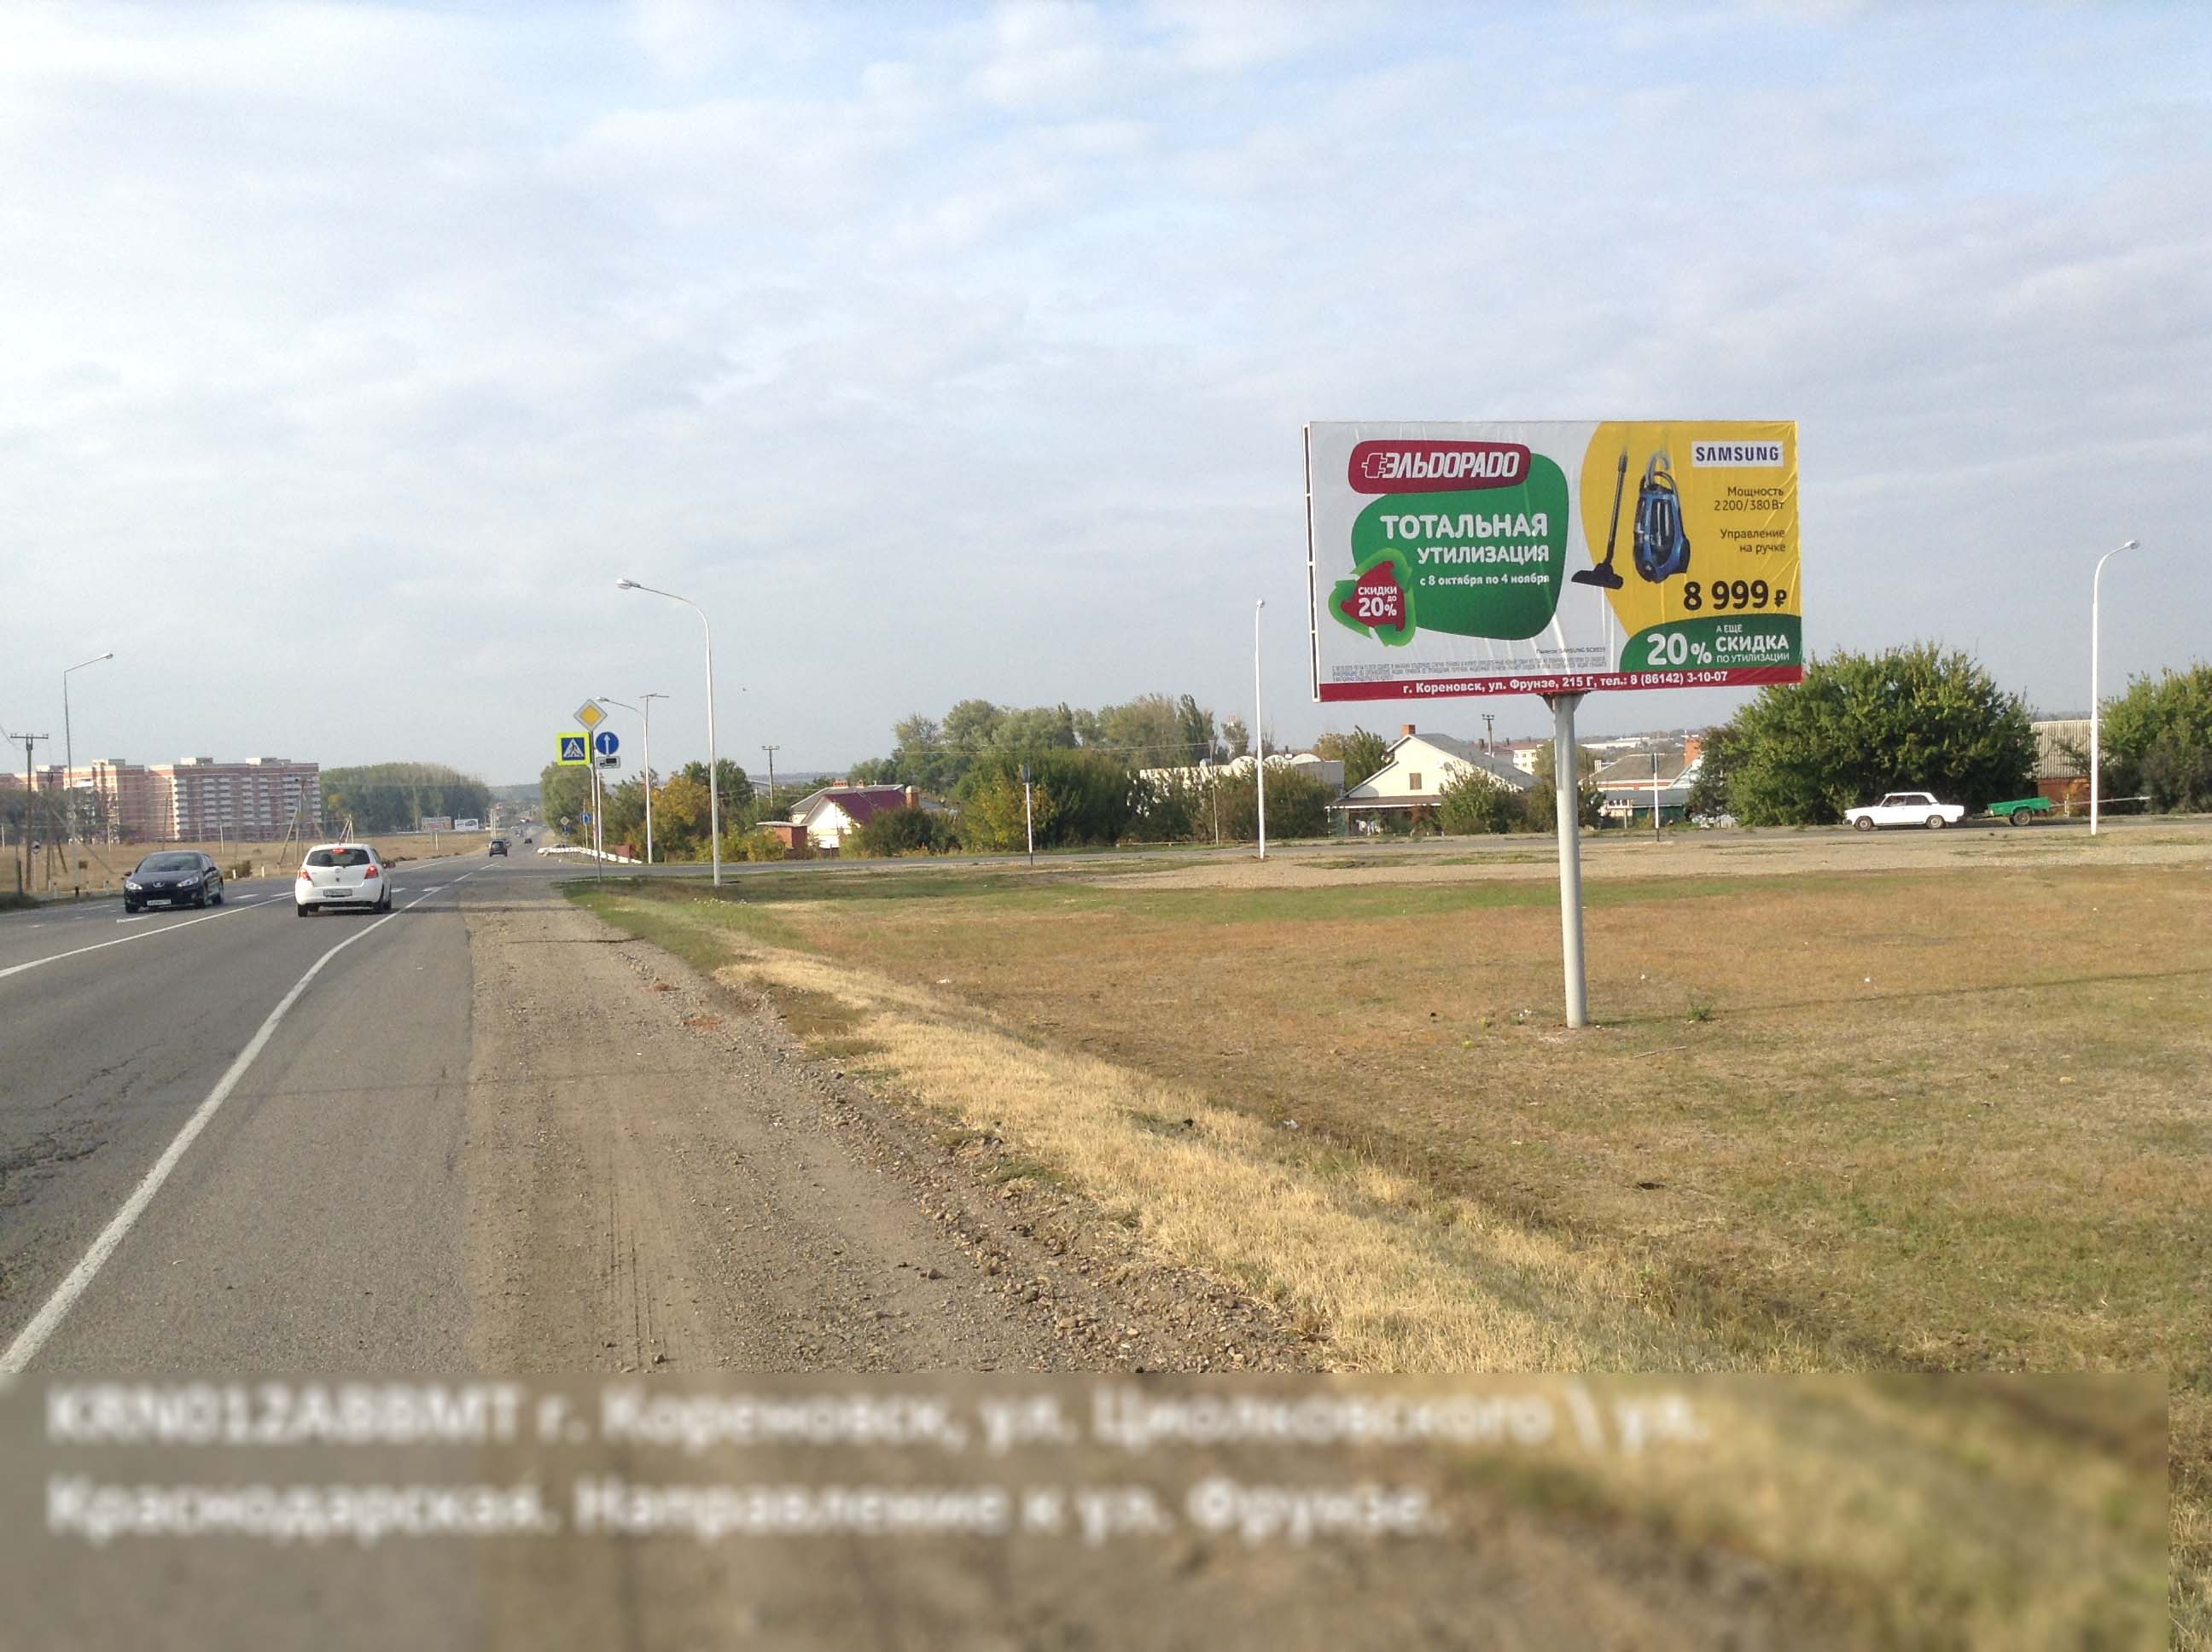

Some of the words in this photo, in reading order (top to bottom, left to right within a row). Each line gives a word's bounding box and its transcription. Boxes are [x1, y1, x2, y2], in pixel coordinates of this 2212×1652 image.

[1696, 446, 1779, 462] SAMSUNG
[1727, 486, 1784, 497] Мощность
[1380, 513, 1548, 539] ТОТАЛЬНАЯ
[1720, 528, 1785, 541] Управление
[1417, 544, 1549, 566] УТИЛИЗАЦИЯ
[1739, 544, 1753, 553] на
[1755, 543, 1786, 555] ручке
[1419, 579, 1426, 587] с
[1428, 575, 1435, 586] 8
[1438, 573, 1483, 588] октября
[1486, 574, 1499, 585] по
[1501, 573, 1509, 584] 4
[1511, 573, 1551, 585] ноября
[1358, 586, 1398, 596] СКИДКИ
[1684, 581, 1703, 611] 8
[1711, 579, 1769, 610] 999
[1358, 596, 1398, 617] 20%
[1715, 625, 1722, 633] А
[1724, 624, 1743, 634] ЕЩЕ
[1715, 635, 1790, 654] СКИДКА
[1716, 655, 1730, 664] ПО
[1732, 653, 1790, 663] УТИЛИЗАЦИИ
[1402, 685, 1412, 694] г.
[1416, 683, 1486, 695] Кореновск,
[1487, 681, 1507, 692] ул.
[1510, 678, 1559, 689] Фрунзе,
[1562, 678, 1584, 688] 215
[1600, 676, 1628, 687] тел.:
[1631, 674, 1638, 685] 8
[1641, 672, 1685, 687] (86142)
[1686, 671, 1729, 683] 3-10-07
